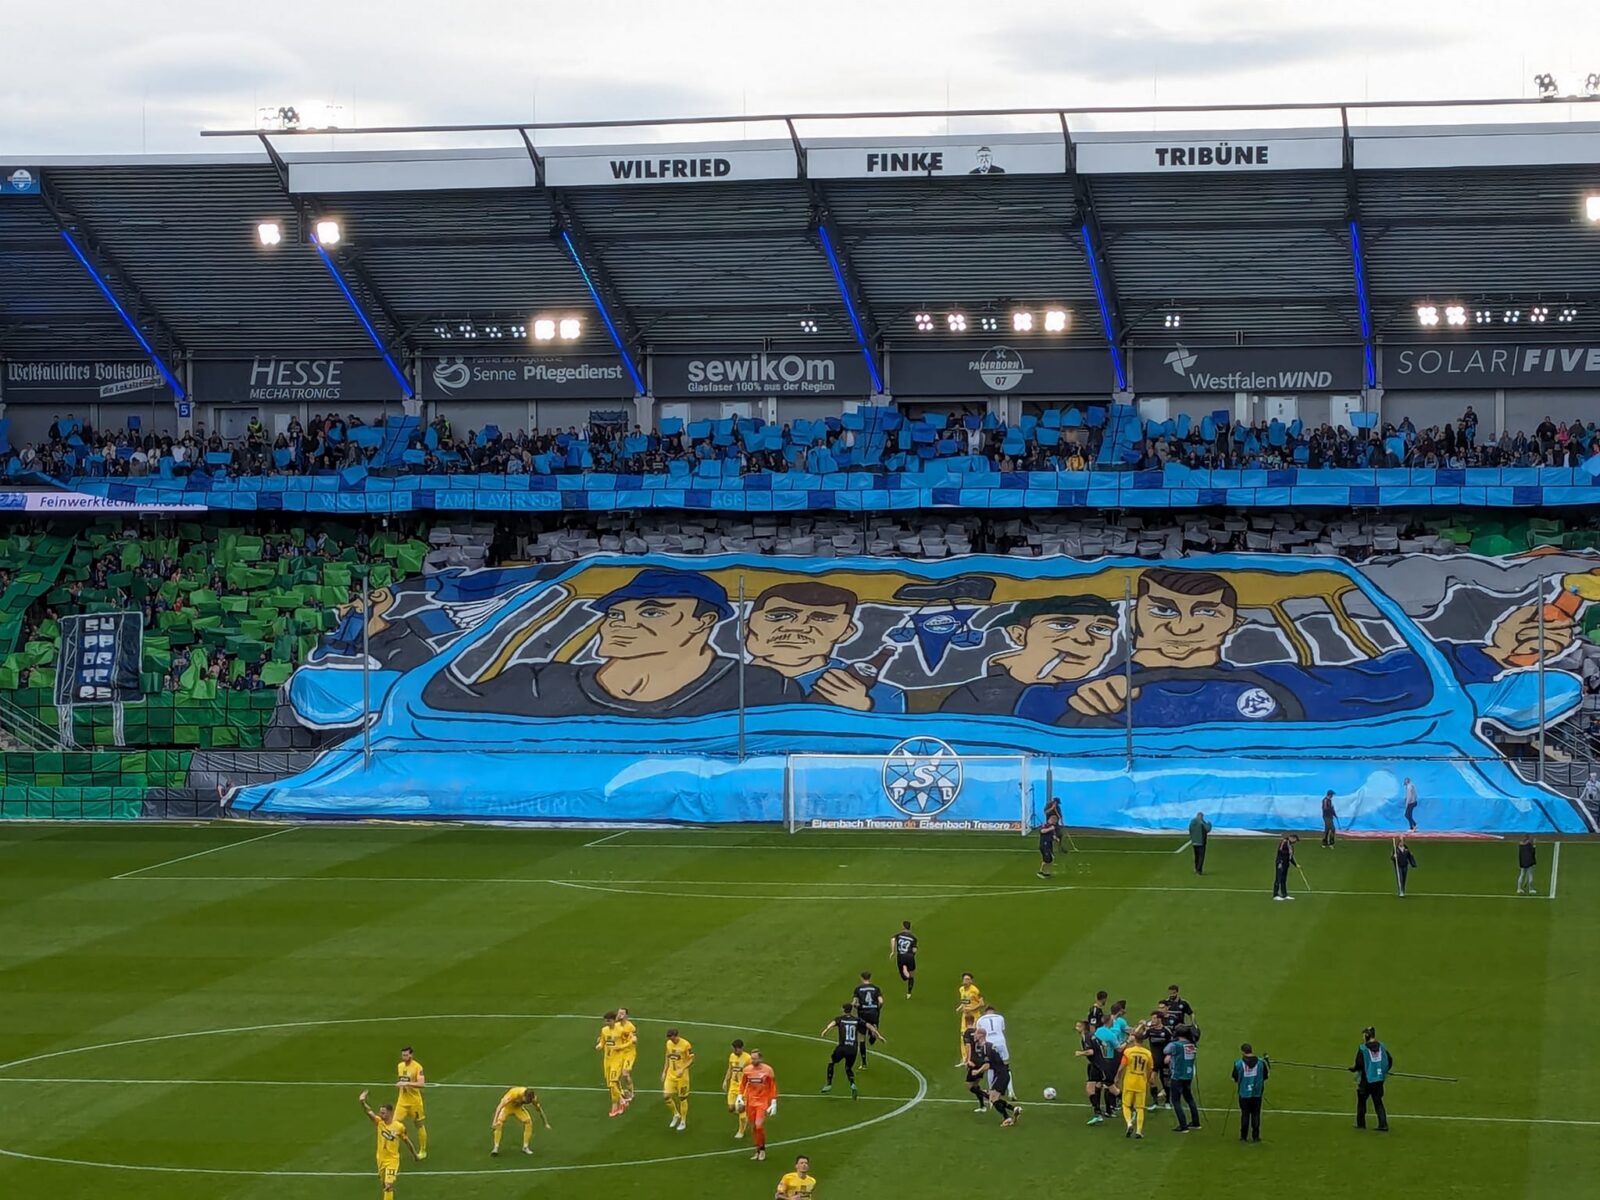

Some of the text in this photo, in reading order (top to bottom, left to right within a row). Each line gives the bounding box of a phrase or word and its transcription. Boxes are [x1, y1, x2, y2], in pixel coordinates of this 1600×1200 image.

[610, 142, 1268, 180] WILFRIED FINKE TRIBÜNE
[95, 362, 159, 381] Volksblat
[250, 355, 344, 386] HESSE
[473, 363, 623, 384] Senne Pflegedienst
[968, 361, 1020, 371] PADERBORN
[688, 382, 733, 393] Glasfaser
[736, 381, 762, 392] 100%
[783, 381, 799, 391] der
[801, 380, 835, 393] Region
[995, 376, 1007, 386] 07
[250, 388, 341, 400] MECHATRONICS
[180, 405, 189, 416] 5
[920, 820, 971, 830] Eisenbach
[864, 991, 873, 1006] 4
[844, 1024, 857, 1041] 10
[1132, 1055, 1146, 1072] 14
